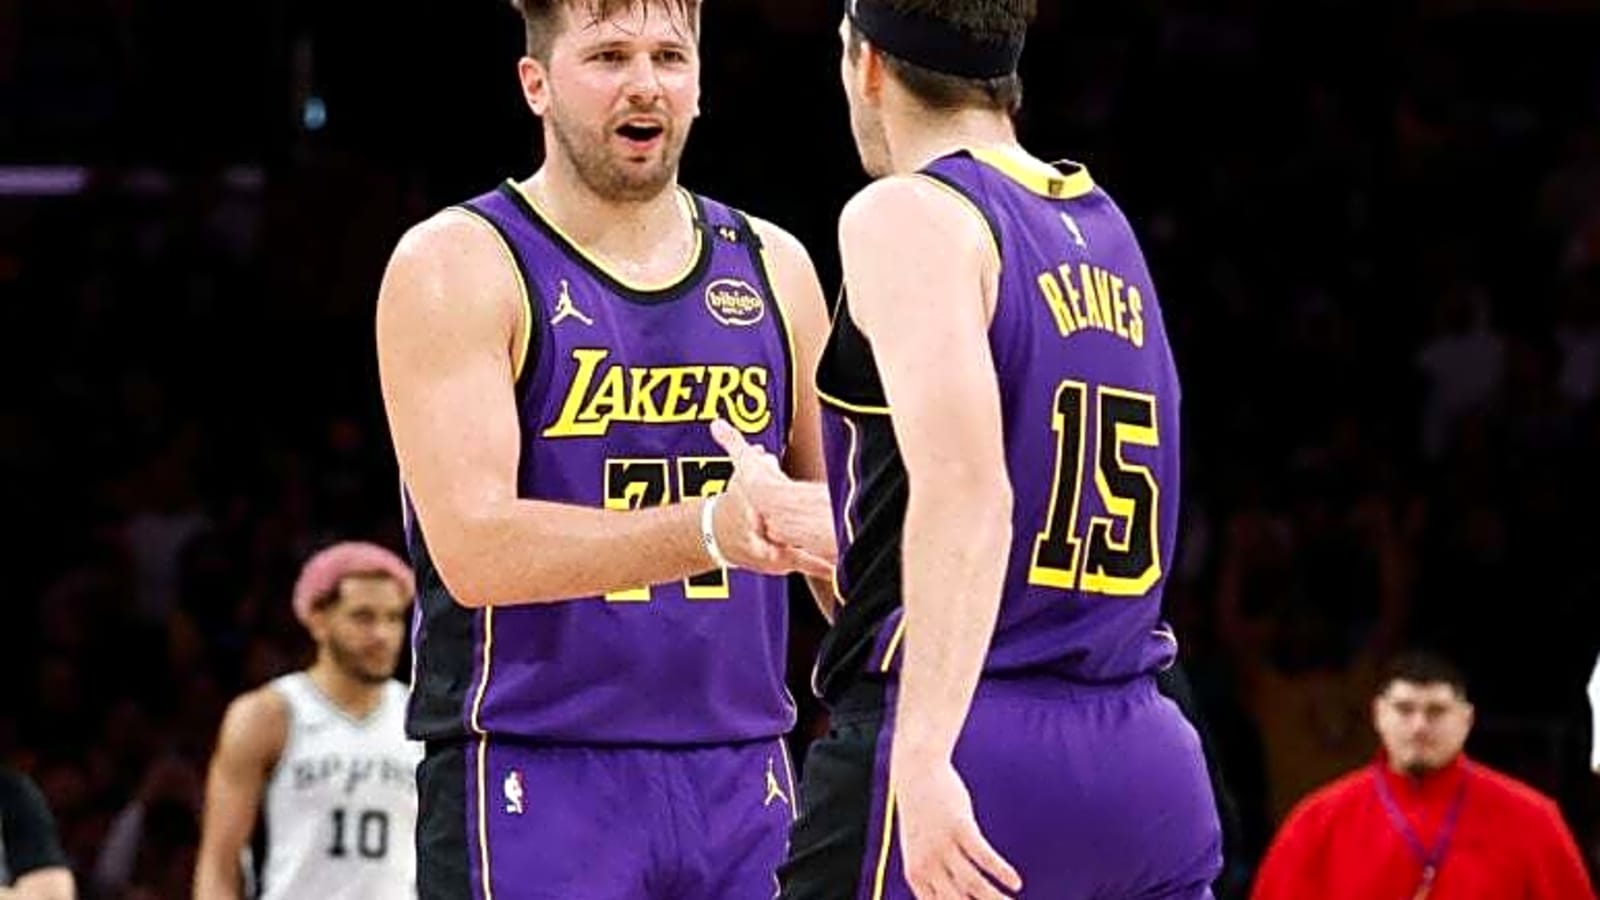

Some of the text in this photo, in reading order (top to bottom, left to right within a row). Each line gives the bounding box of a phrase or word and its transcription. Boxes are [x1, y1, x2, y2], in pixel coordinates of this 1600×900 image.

[1037, 263, 1144, 347] REAVES
[543, 349, 771, 437] LAKERS
[1028, 379, 1162, 596] 15
[329, 808, 390, 859] 10
